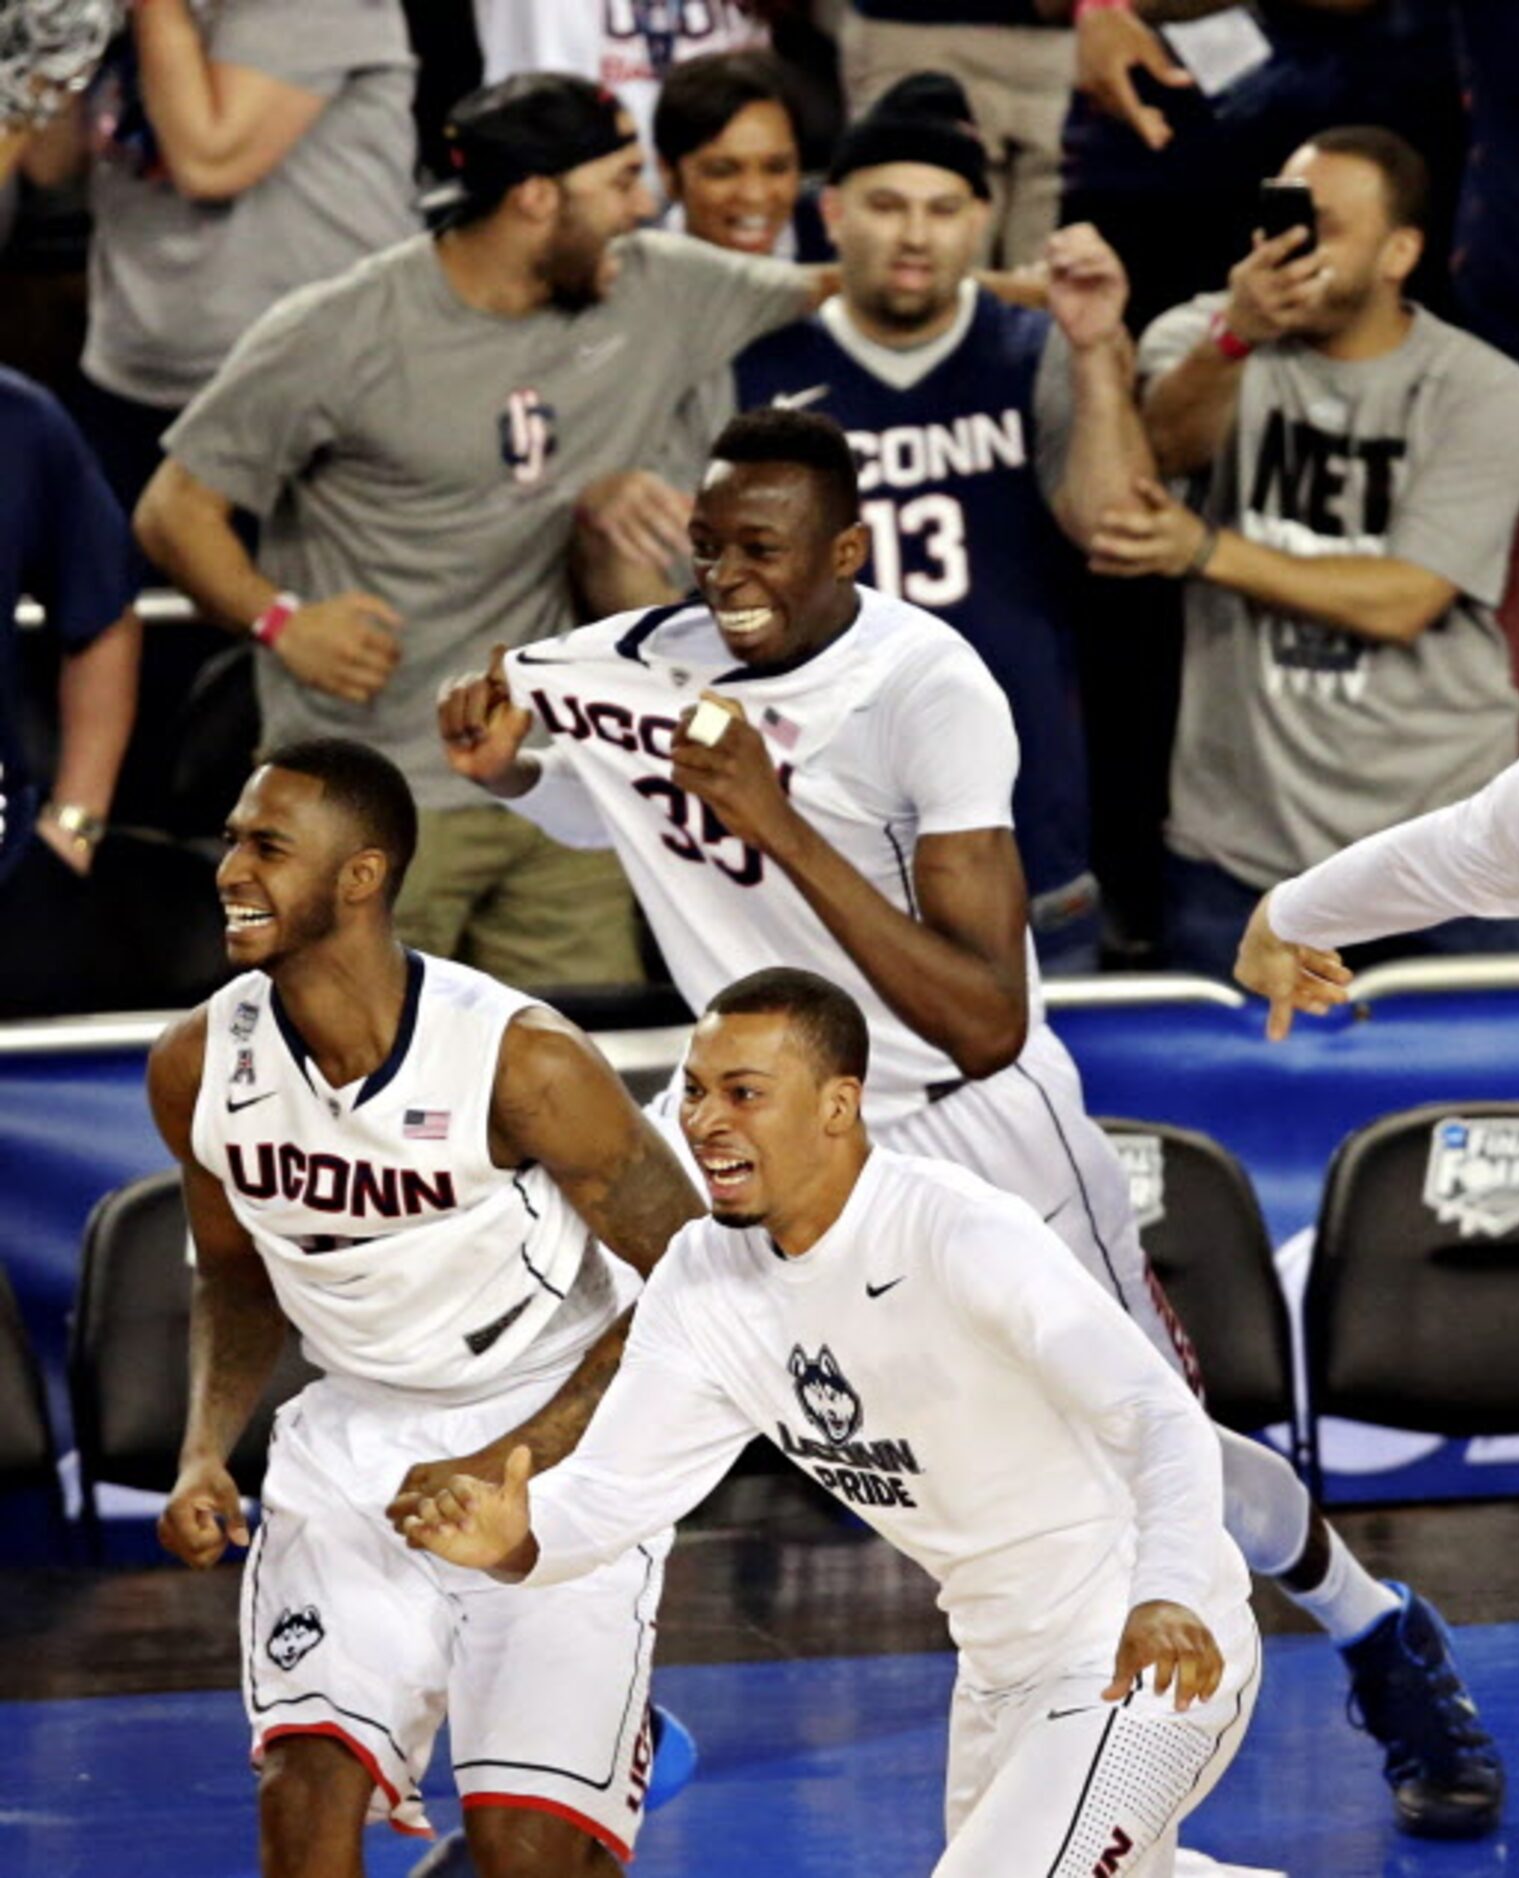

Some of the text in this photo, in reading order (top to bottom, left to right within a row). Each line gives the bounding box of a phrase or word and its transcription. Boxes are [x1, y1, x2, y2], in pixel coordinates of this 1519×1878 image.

[843, 408, 1026, 493] CONN
[1249, 408, 1407, 537] NET
[859, 493, 970, 606] 13
[631, 775, 764, 888] 35
[225, 1142, 458, 1218] UCONN
[813, 1465, 918, 1508] PRIDE
